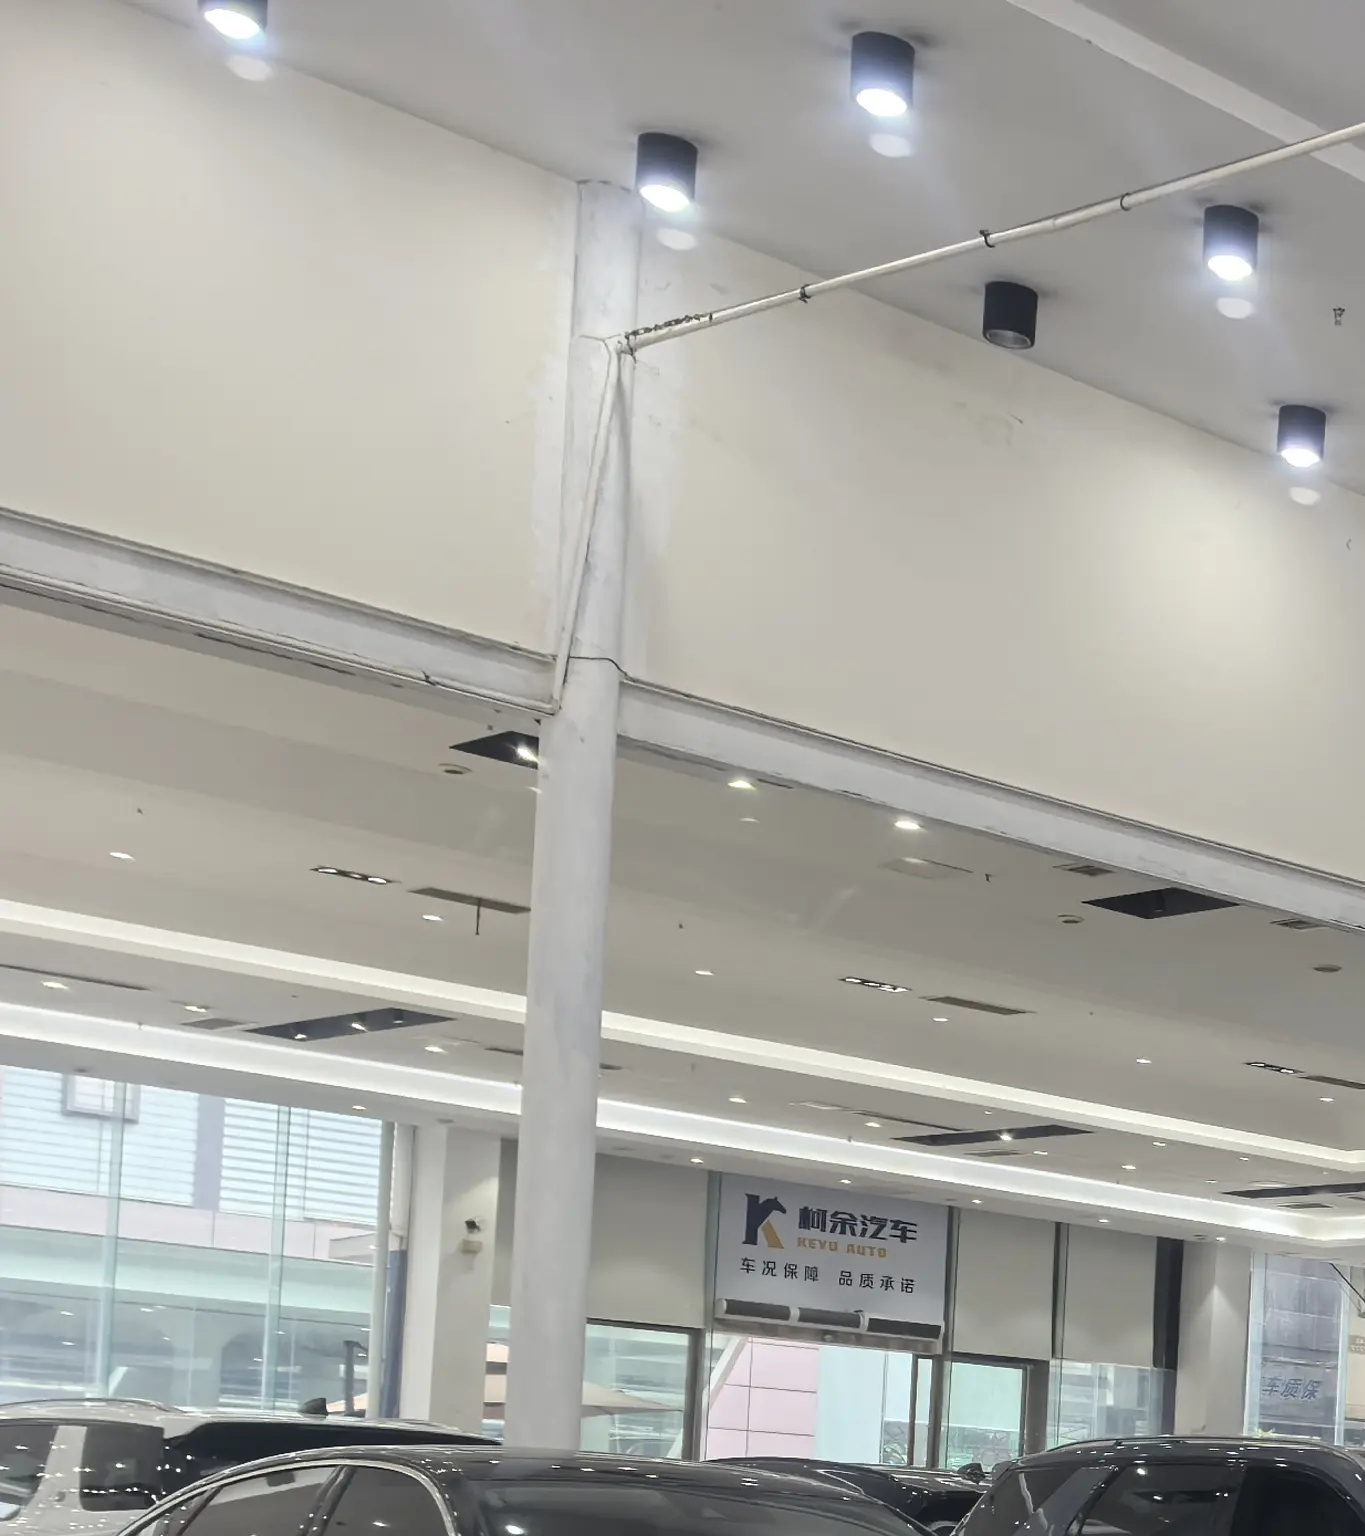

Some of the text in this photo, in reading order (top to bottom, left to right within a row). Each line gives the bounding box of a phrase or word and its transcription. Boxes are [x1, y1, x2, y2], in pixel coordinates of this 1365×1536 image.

[798, 1206, 918, 1244] 柯余汽车
[847, 1243, 887, 1258] AUTO
[739, 1257, 916, 1294] 车况保障 品质承诺
